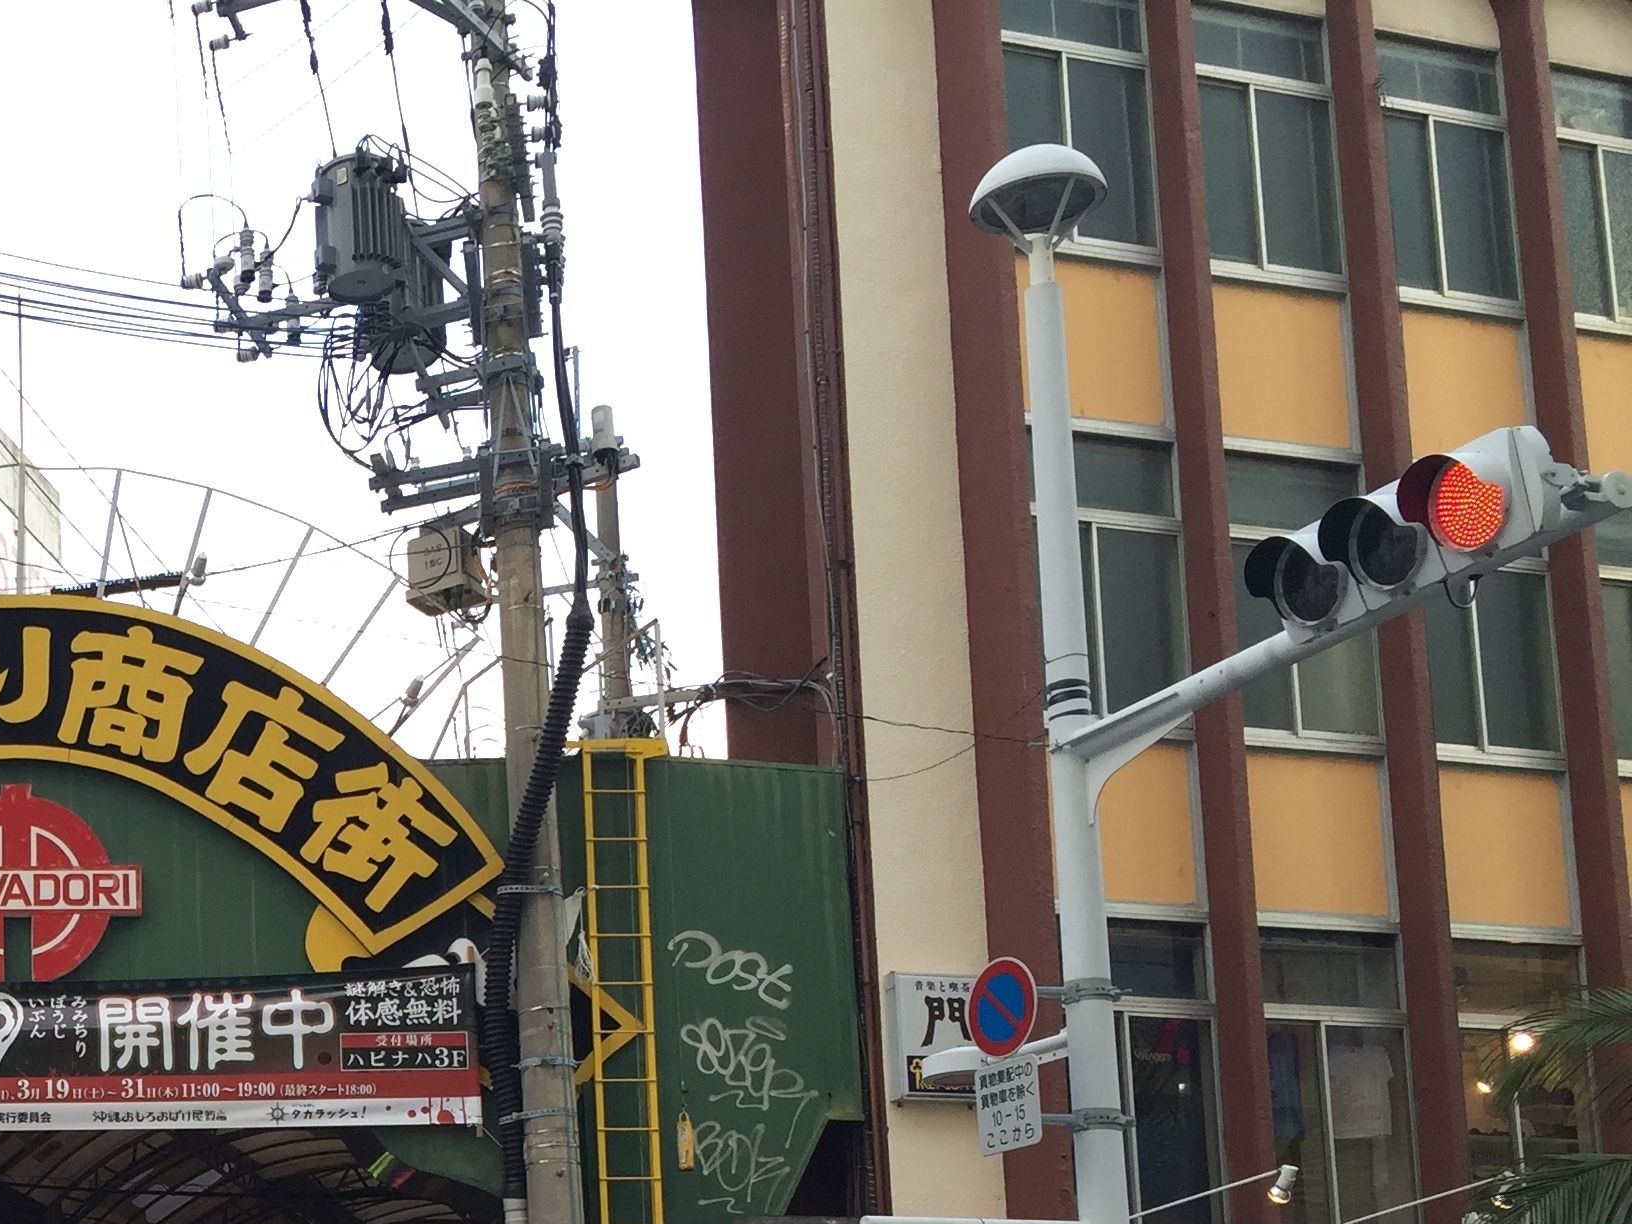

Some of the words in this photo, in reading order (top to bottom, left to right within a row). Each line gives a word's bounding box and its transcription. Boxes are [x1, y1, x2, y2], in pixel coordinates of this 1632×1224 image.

[28, 998, 46, 1039] いぶん
[71, 995, 89, 1059] みみちり
[344, 997, 462, 1027] 体感無料
[97, 988, 335, 1072] 開催中
[978, 1062, 1034, 1091] 貨物集配中の
[980, 1081, 1035, 1109] 貨物車を除く
[987, 1123, 1035, 1149] ここから
